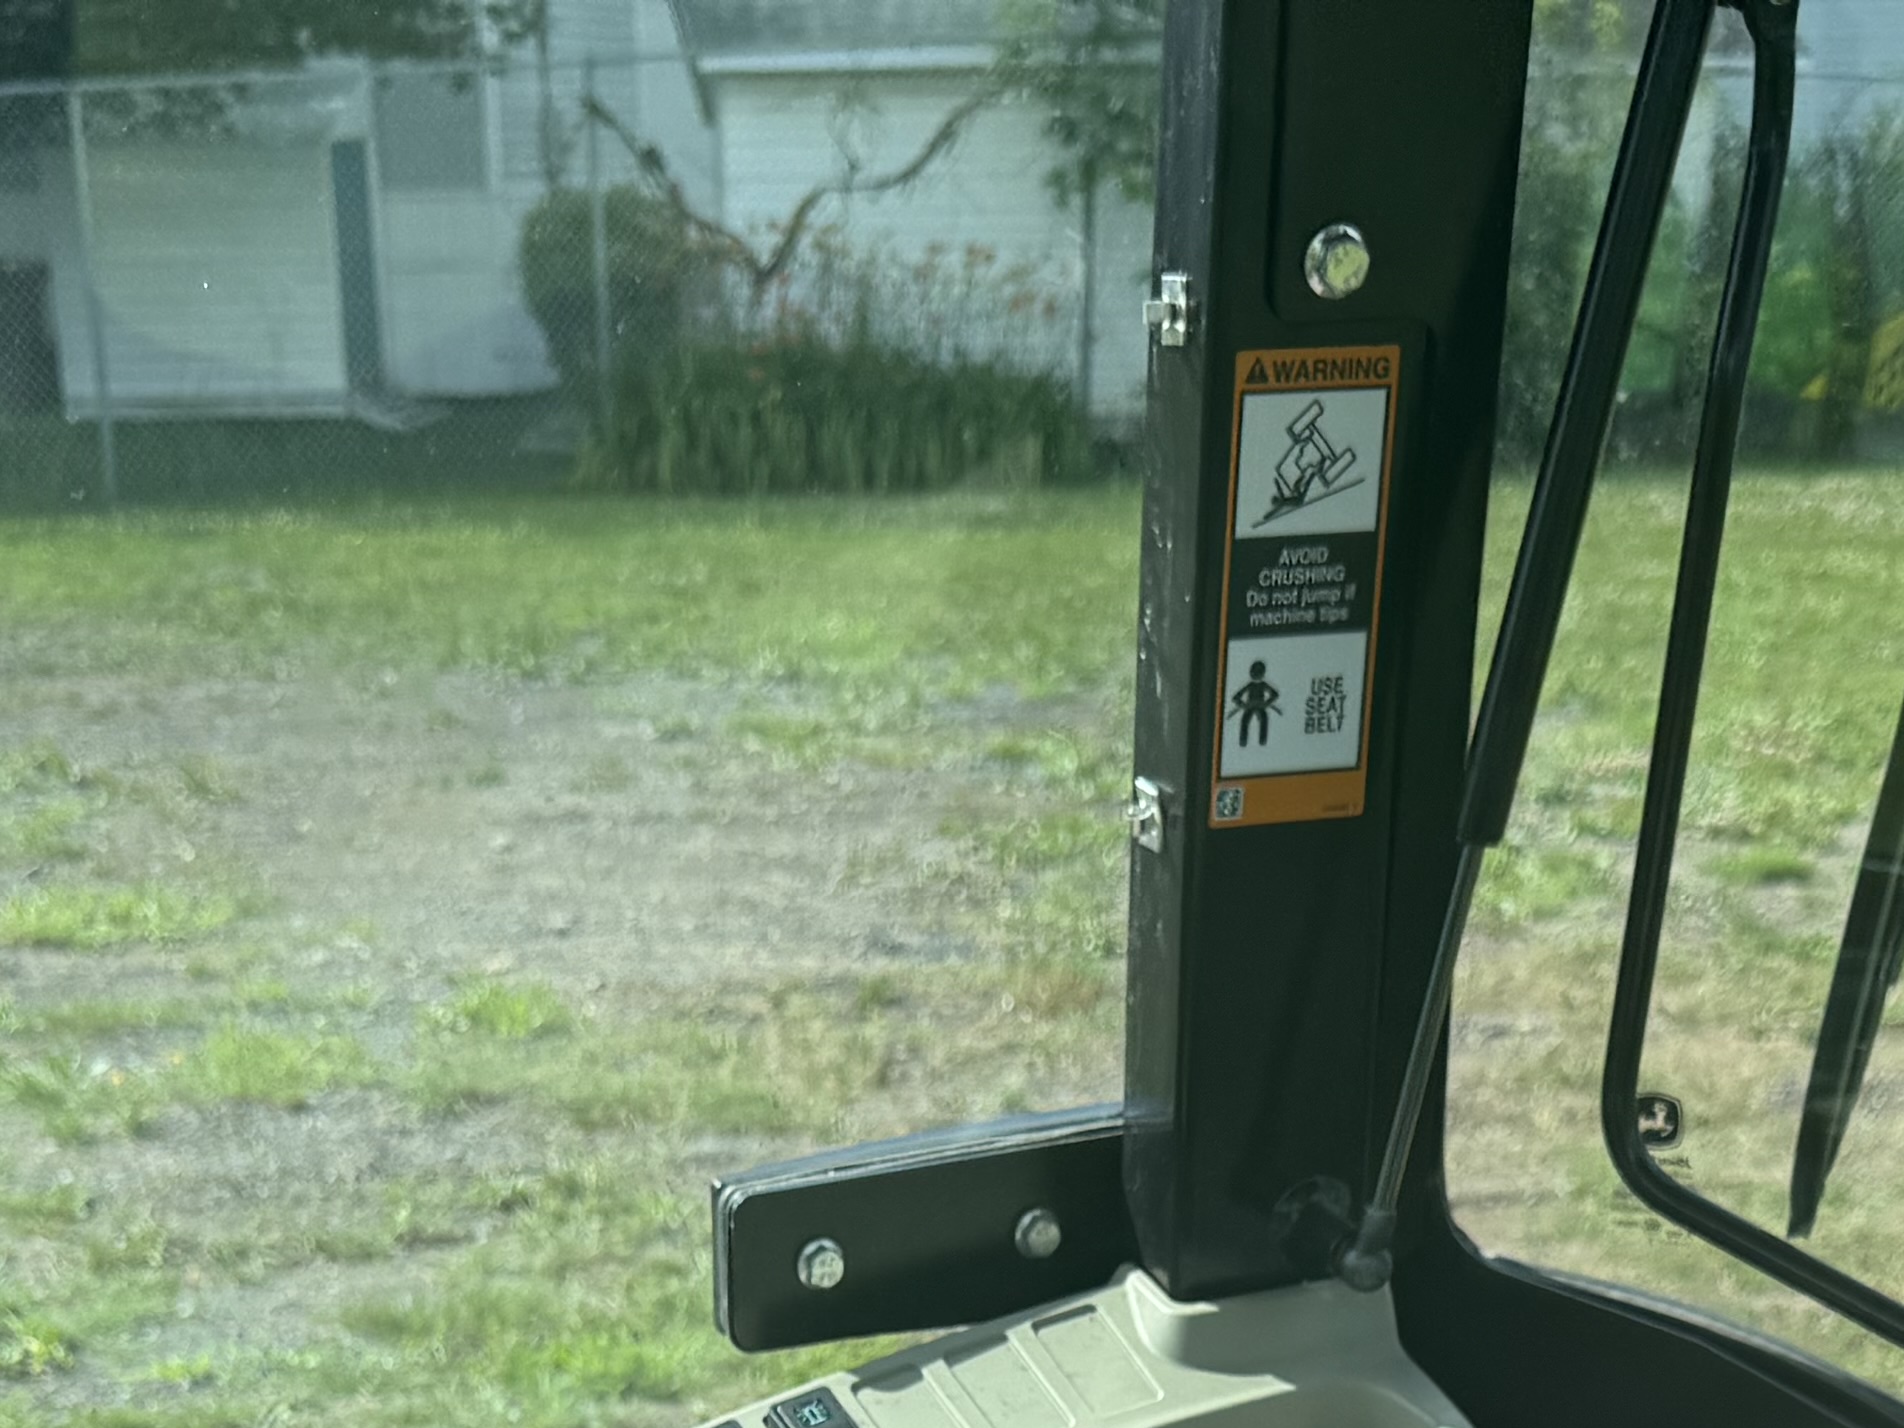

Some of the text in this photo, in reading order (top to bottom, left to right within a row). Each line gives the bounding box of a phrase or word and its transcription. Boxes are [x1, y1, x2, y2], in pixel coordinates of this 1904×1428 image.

[1272, 356, 1390, 383] WARNING
[1278, 547, 1329, 567] AVOID
[1258, 565, 1345, 587] CRUSHING
[1246, 590, 1269, 608] Do
[1271, 588, 1298, 605] not
[1301, 585, 1341, 607] jump
[1249, 605, 1348, 627] machine tips
[1311, 677, 1343, 695] USE
[1305, 695, 1346, 716] SEAT
[1304, 716, 1343, 734] BELT
